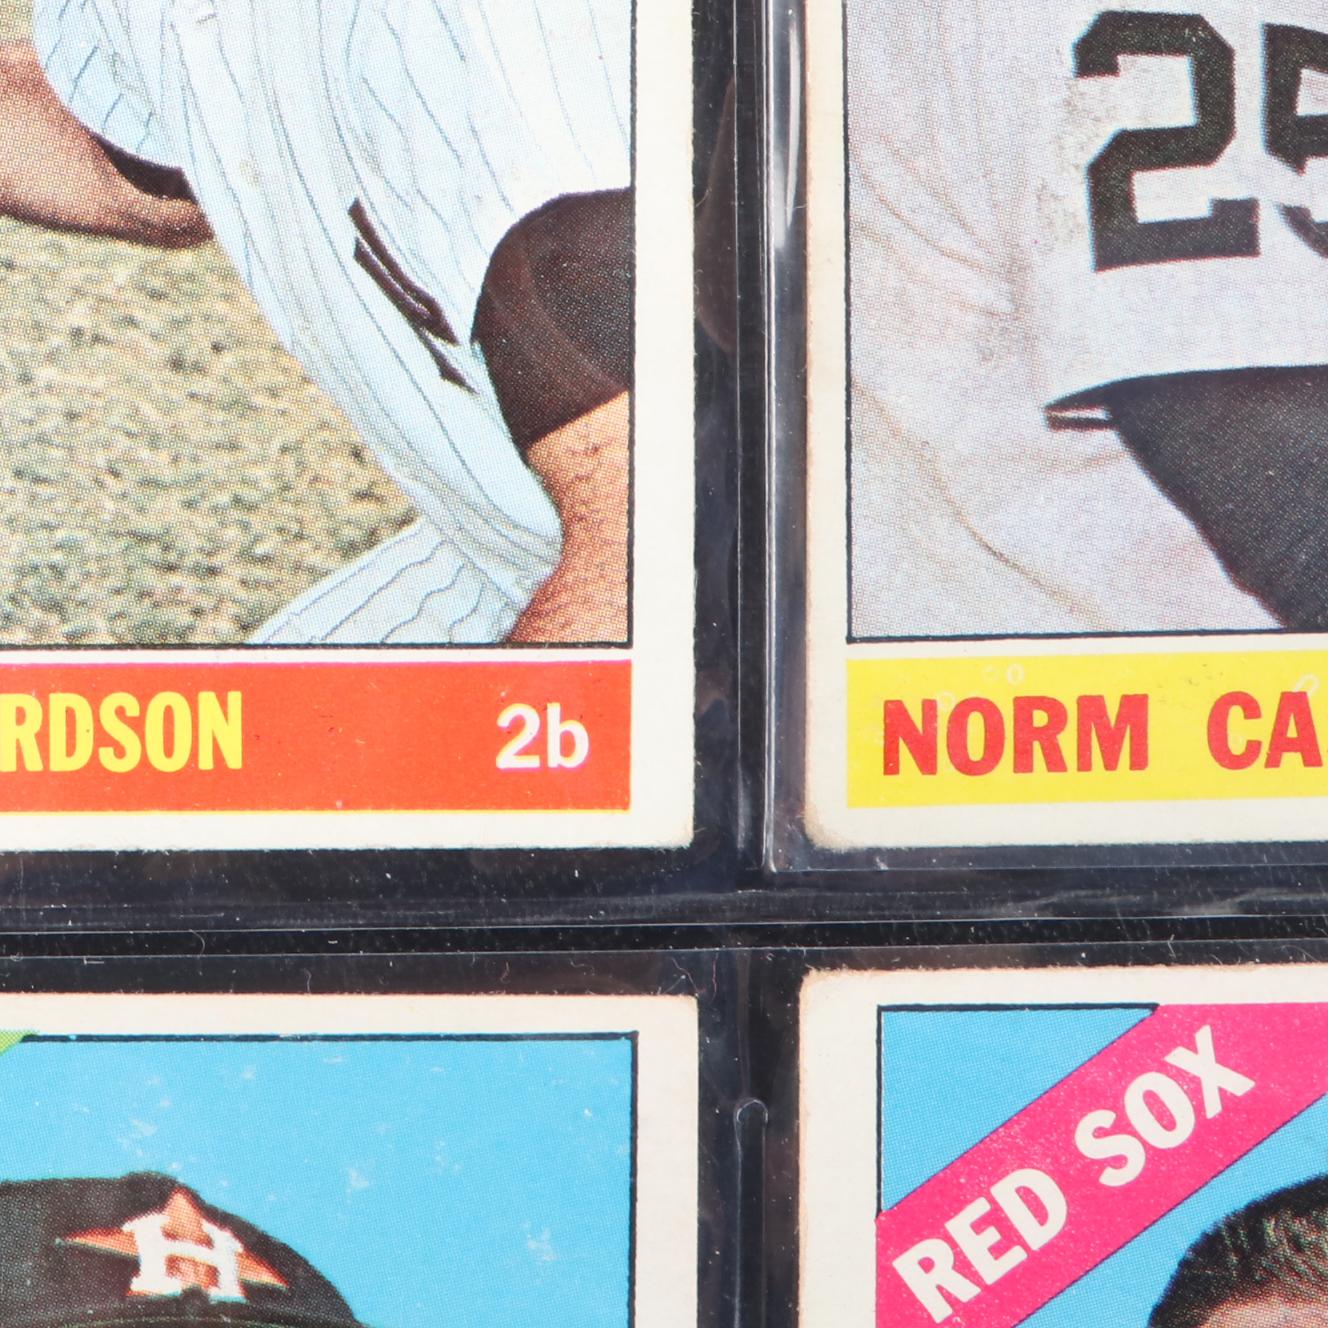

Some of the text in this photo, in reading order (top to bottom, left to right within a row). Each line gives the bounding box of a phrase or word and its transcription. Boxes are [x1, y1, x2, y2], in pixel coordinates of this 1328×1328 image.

[495, 703, 591, 771] 2b
[882, 694, 1150, 777] NORM
[891, 1023, 1257, 1324] RED SOX
